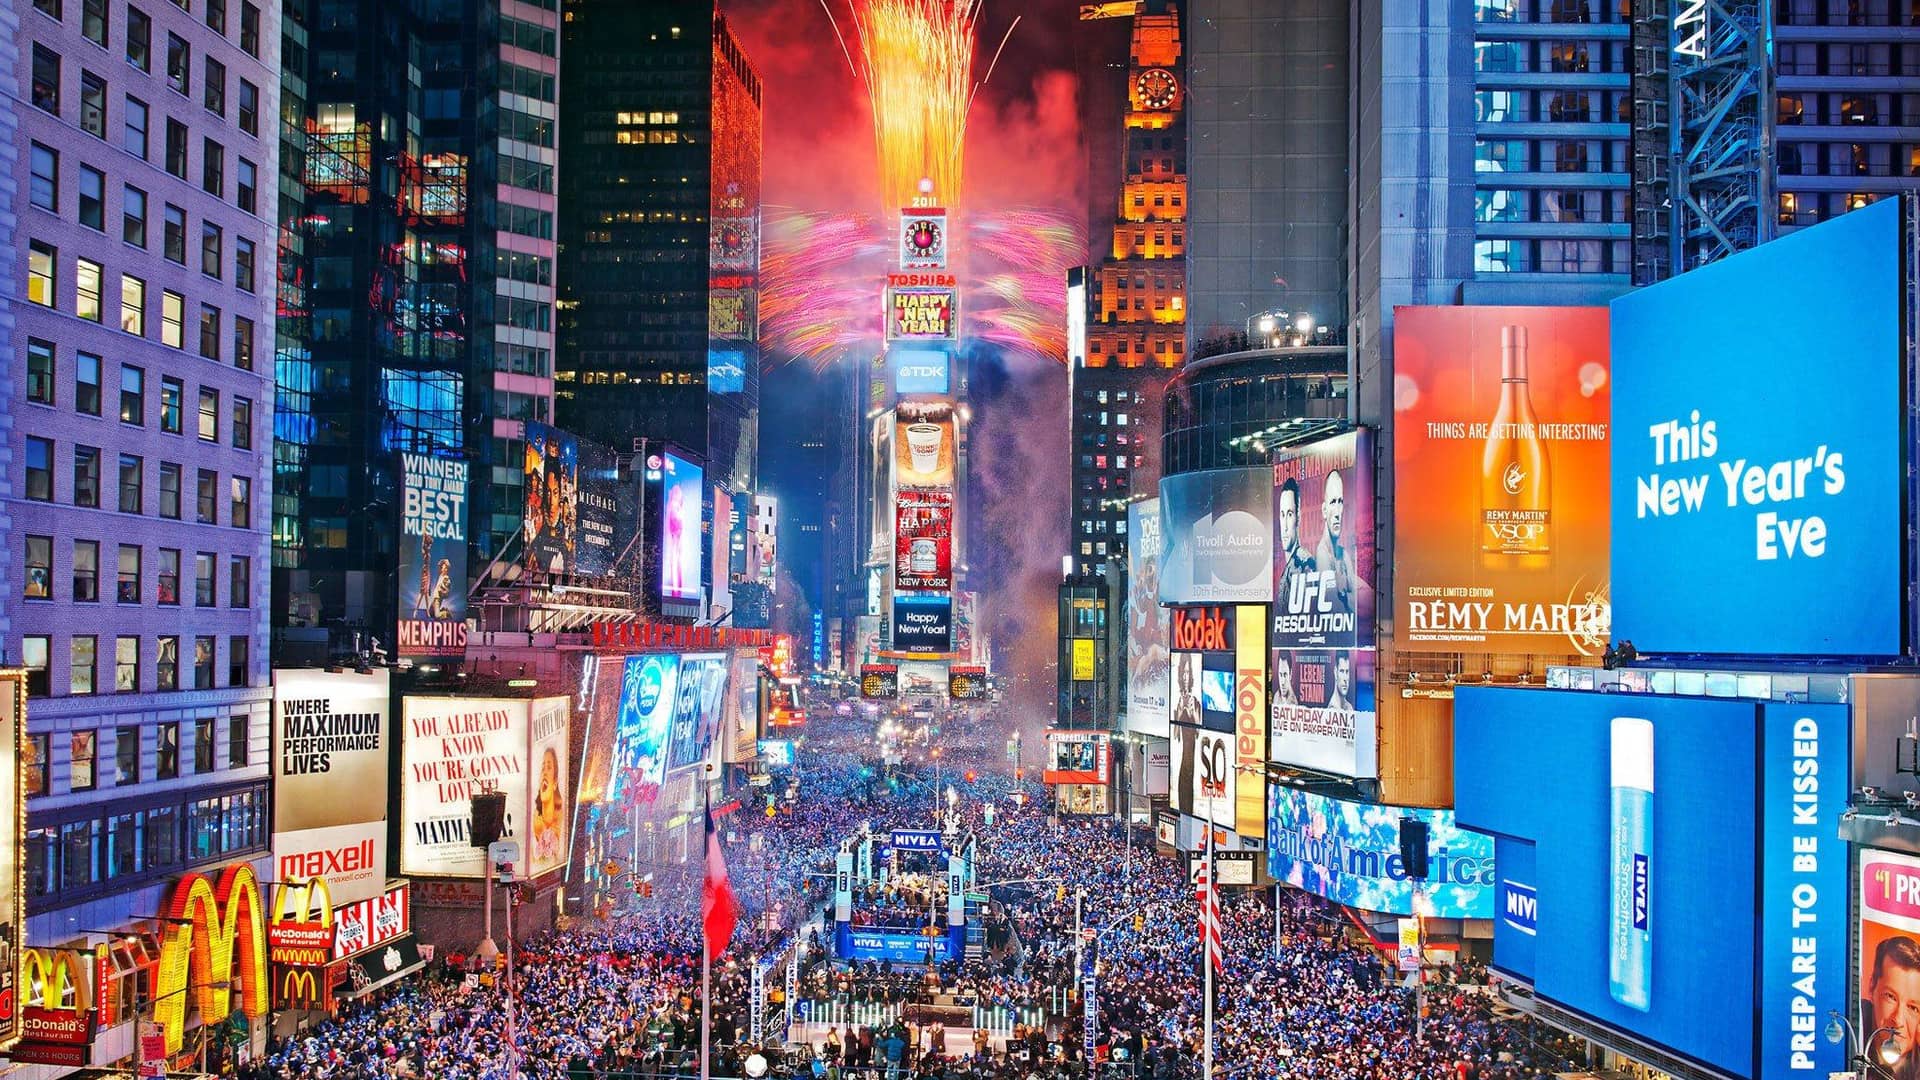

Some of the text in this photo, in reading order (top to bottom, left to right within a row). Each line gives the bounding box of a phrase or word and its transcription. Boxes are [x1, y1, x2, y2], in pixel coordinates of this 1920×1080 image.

[912, 197, 937, 208] 2011
[888, 274, 957, 287] TOSHIBA
[895, 294, 950, 308] HAPPY
[904, 307, 942, 321] NEW
[899, 320, 946, 335] YEAR!
[913, 366, 944, 377] TDK
[1427, 423, 1465, 439] THINGS
[1469, 423, 1489, 439] ARE
[1491, 423, 1536, 440] GETTING
[1650, 409, 1718, 465] This
[402, 453, 467, 482] WINNER!
[1274, 458, 1301, 487] EDGAR
[405, 475, 464, 494] 2010 TONY AWARD
[1637, 445, 1845, 519] New Year's
[404, 487, 465, 523] BEST
[579, 490, 617, 512] MICHAEL
[404, 518, 464, 540] MUSICAL
[900, 518, 948, 528] HAPPY
[1487, 524, 1545, 539] VSOP
[1196, 533, 1263, 547] Tivoli Audio
[1756, 512, 1827, 561] Eve
[899, 578, 948, 587] NEW YORK
[1212, 586, 1271, 599] Anniversary
[1288, 571, 1336, 614] UFC
[1409, 587, 1494, 598] EXCLUSIVE LIMITED EDITION
[906, 613, 938, 623] Happy
[1274, 613, 1354, 633] RESOLUTION
[1409, 600, 1494, 630] RÉMY
[398, 621, 467, 648] MEMPHIS
[899, 625, 946, 634] New Year!
[1175, 607, 1228, 649] Kodak
[283, 699, 330, 715] WHERE
[1273, 706, 1324, 724] SATURDAY
[284, 713, 380, 738] MAXIMUM
[412, 709, 511, 738] YOU ALREADY
[1238, 669, 1262, 777] Kodak
[1273, 719, 1355, 740] LIVE ON PAY-PER-VIEW
[283, 735, 379, 755] PERFORMANCE
[442, 734, 486, 758] KNOW
[283, 753, 330, 776] LIVES
[413, 754, 520, 783] YOU'RE GONNA
[439, 780, 473, 803] LOVE
[896, 835, 938, 846] NIVEA
[280, 838, 374, 880] maxell
[1269, 816, 1308, 861] Bank
[1310, 833, 1328, 867] of
[1329, 836, 1495, 886] Ameica
[327, 871, 373, 884] maxell.com
[1636, 860, 1646, 924] NIVEA
[1791, 718, 1818, 1069] PREPARE TO BE KISSED
[1619, 863, 1631, 961] Smoothness
[271, 928, 330, 938] McDonald's
[854, 939, 883, 948] NIVEA
[15, 1051, 80, 1062] OPEN 24 HOURS
